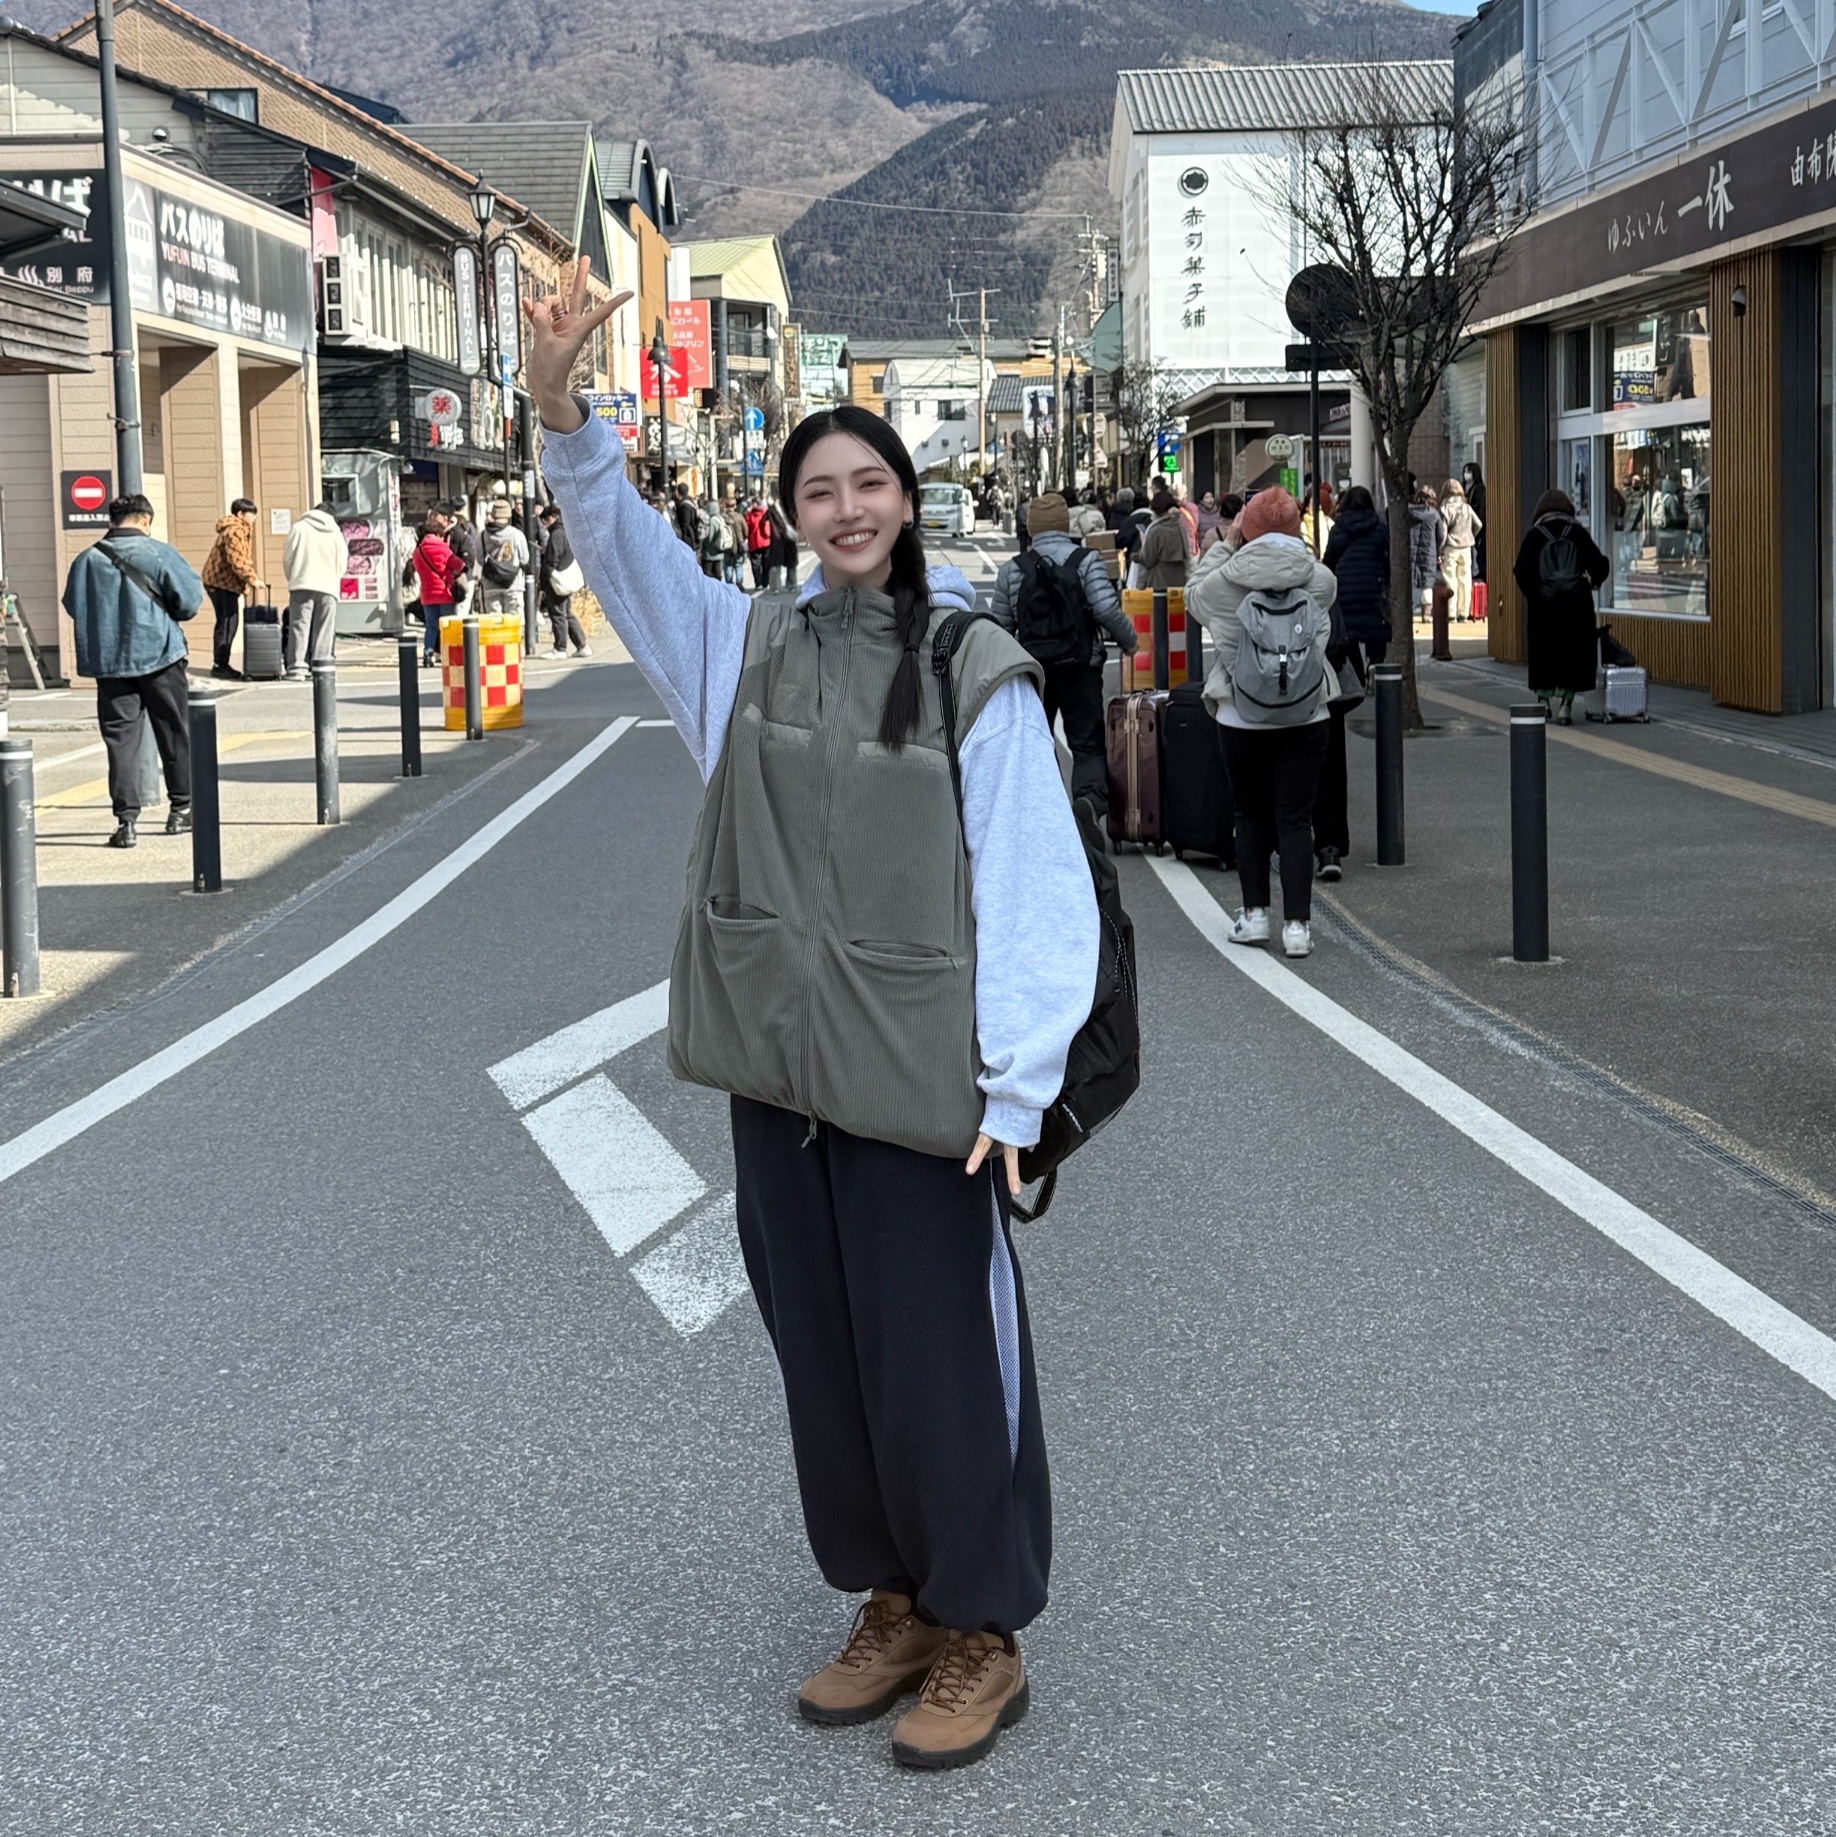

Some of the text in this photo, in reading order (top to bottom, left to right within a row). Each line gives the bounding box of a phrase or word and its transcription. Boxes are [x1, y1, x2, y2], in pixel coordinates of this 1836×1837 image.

[160, 202, 225, 258] バスのりば
[1607, 159, 1734, 253] ゆふいん 一休
[190, 250, 206, 273] BUS
[460, 253, 474, 353] BUS TERMINAL
[498, 253, 516, 345] バスのりば
[596, 406, 618, 417] 500
